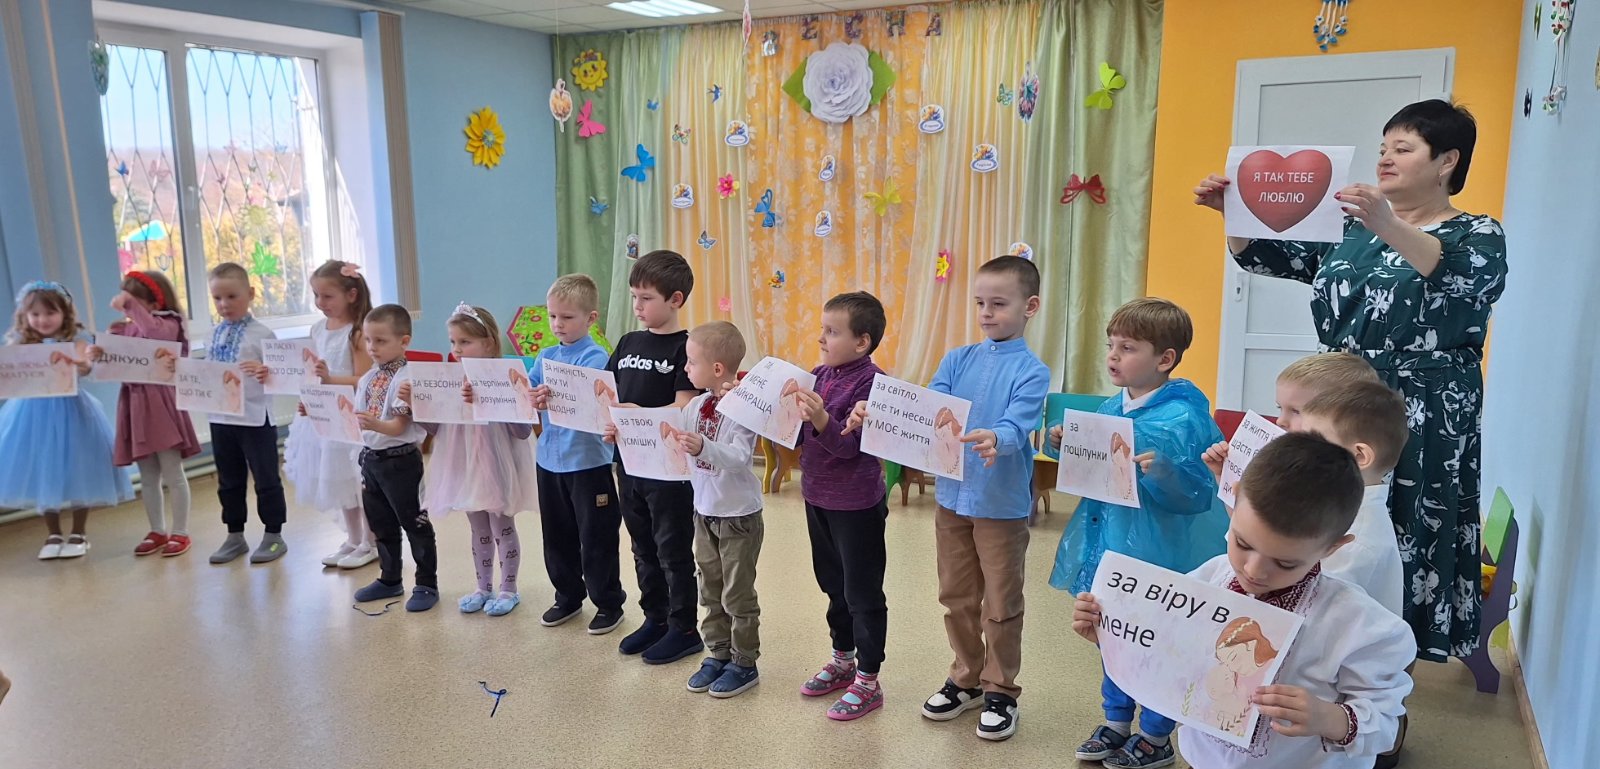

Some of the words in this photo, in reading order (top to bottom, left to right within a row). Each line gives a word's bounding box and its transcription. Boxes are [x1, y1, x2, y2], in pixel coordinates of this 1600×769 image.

[1253, 172, 1261, 183] Я
[1263, 172, 1284, 183] ТАК
[1287, 172, 1315, 183] ТЕБЕ
[1258, 191, 1305, 203] ЛЮБЛЮ
[98, 352, 149, 366] ДЯКУЮ
[618, 354, 653, 371] adidas
[269, 367, 285, 376] ВОГО
[544, 362, 552, 371] ЗА
[553, 365, 588, 380] НІЖНІСТЬ,
[412, 379, 422, 388] ЗА
[423, 380, 463, 388] БЕЗСОННІ
[480, 379, 510, 389] терпіння
[545, 376, 557, 386] ЯКУ
[559, 379, 569, 388] ТИ
[414, 392, 433, 401] НОЧІ
[547, 390, 577, 402] ДАРУЄШ
[875, 382, 886, 391] за
[888, 385, 919, 403] світло,
[480, 395, 517, 405] розуміння
[733, 387, 772, 415] АЙКРАЩА
[549, 404, 576, 415] ЩОДНЯ
[870, 401, 887, 411] яке
[889, 405, 900, 416] ти
[902, 411, 934, 427] несеш
[620, 418, 630, 426] за
[631, 418, 653, 427] твою
[1069, 422, 1079, 432] за
[867, 418, 873, 428] у
[875, 419, 899, 436] МОЄ
[900, 429, 930, 445] життя
[1242, 419, 1250, 429] за
[1249, 424, 1270, 441] життя
[622, 436, 657, 448] усмішку
[1231, 440, 1252, 457] щастя
[1064, 444, 1108, 462] поцілунки
[1228, 460, 1243, 477] твоє
[1107, 571, 1138, 594] за
[1144, 583, 1207, 619] віру
[1211, 606, 1230, 624] в
[1098, 611, 1155, 648] мене
